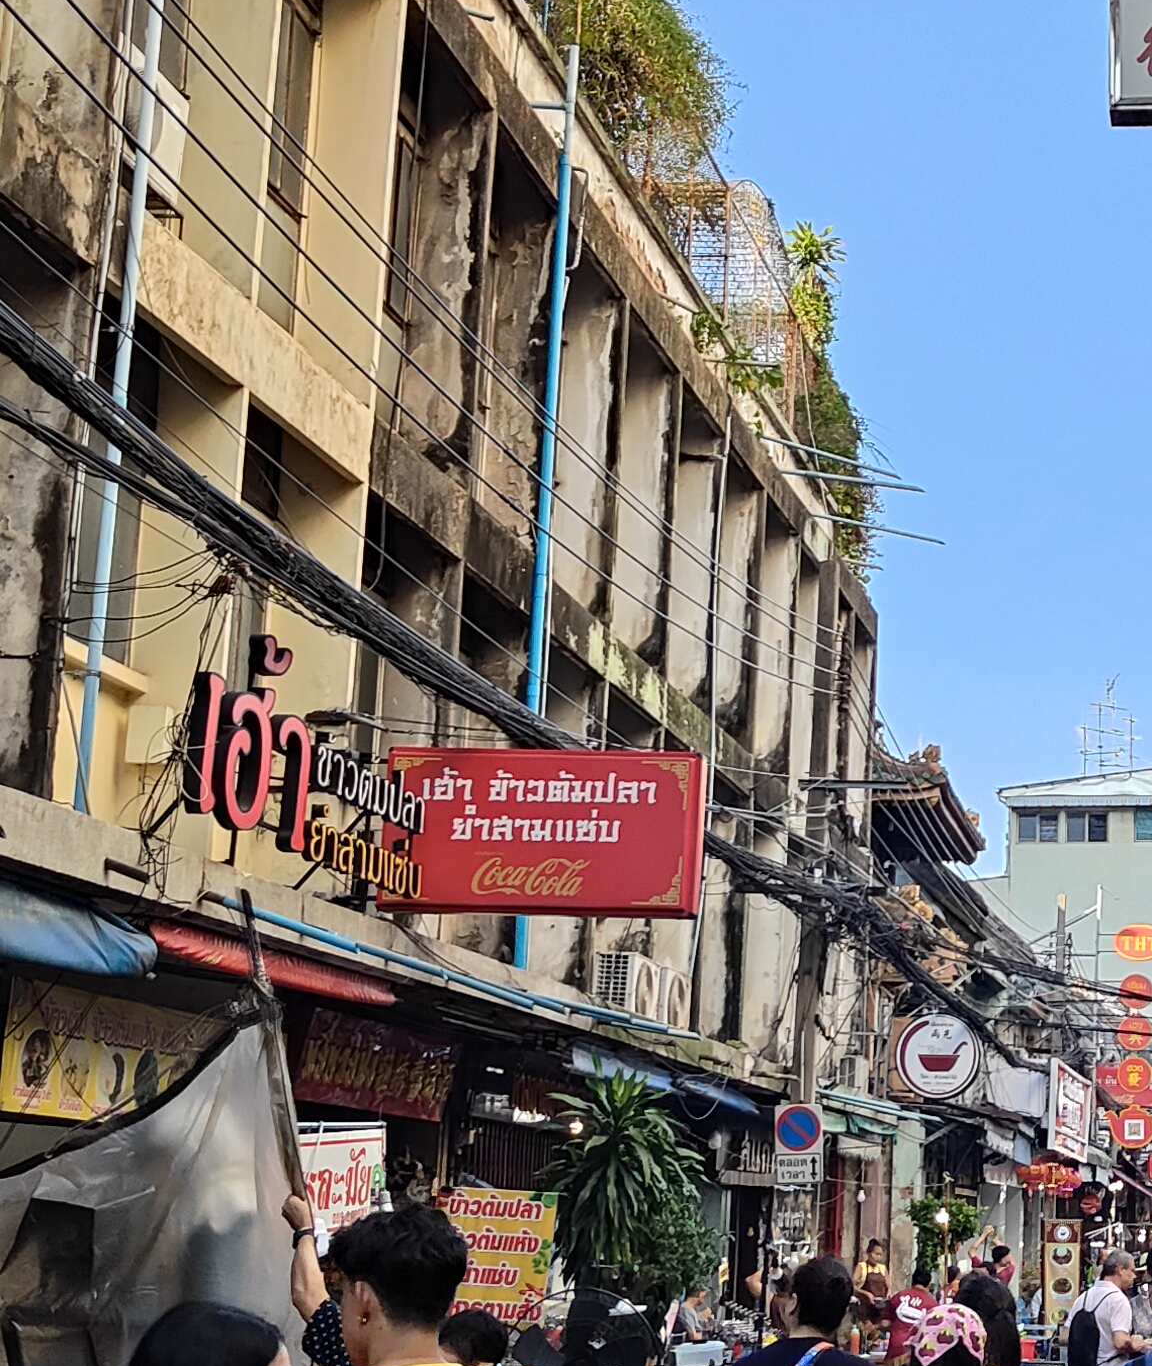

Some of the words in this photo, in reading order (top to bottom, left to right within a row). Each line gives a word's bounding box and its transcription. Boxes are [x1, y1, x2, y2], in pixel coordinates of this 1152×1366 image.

[488, 769, 657, 804] ข้าวต้มปลา
[450, 804, 622, 843] ยำสามแซ่บ
[471, 857, 591, 896] Coca-Cola
[778, 1158, 808, 1168] ตลอด
[781, 1170, 806, 1180] เวลา
[450, 1192, 542, 1220] ข้าวต้มปลา
[454, 1225, 540, 1253] ้าวต้มแห้ง
